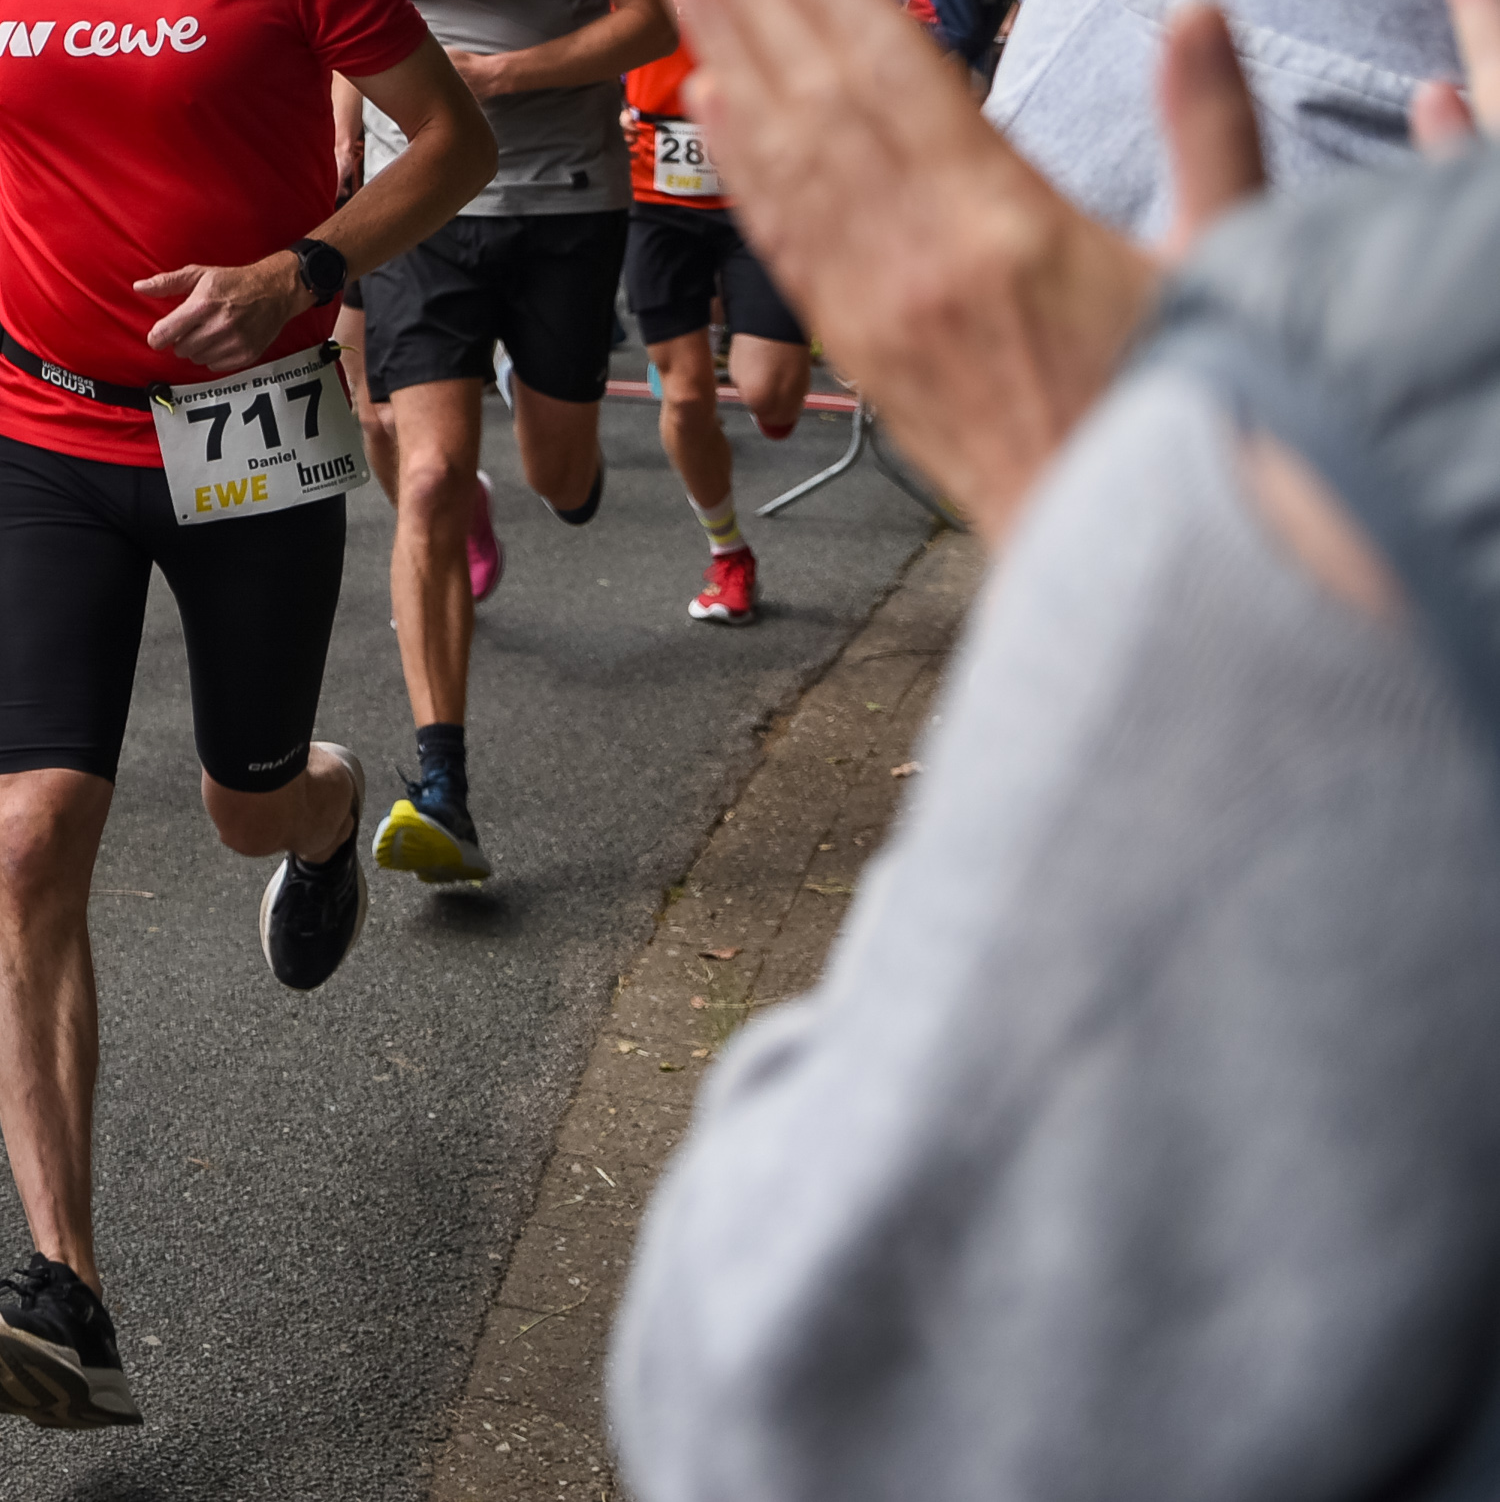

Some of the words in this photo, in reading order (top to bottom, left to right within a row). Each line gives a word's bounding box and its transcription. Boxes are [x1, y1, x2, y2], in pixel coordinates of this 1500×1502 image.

[63, 15, 207, 57] cewe
[252, 359, 326, 389] Brunnenlau
[186, 378, 323, 463] 717
[247, 449, 297, 470] Daniel
[296, 453, 355, 487] bruns
[194, 473, 269, 513] EWE
